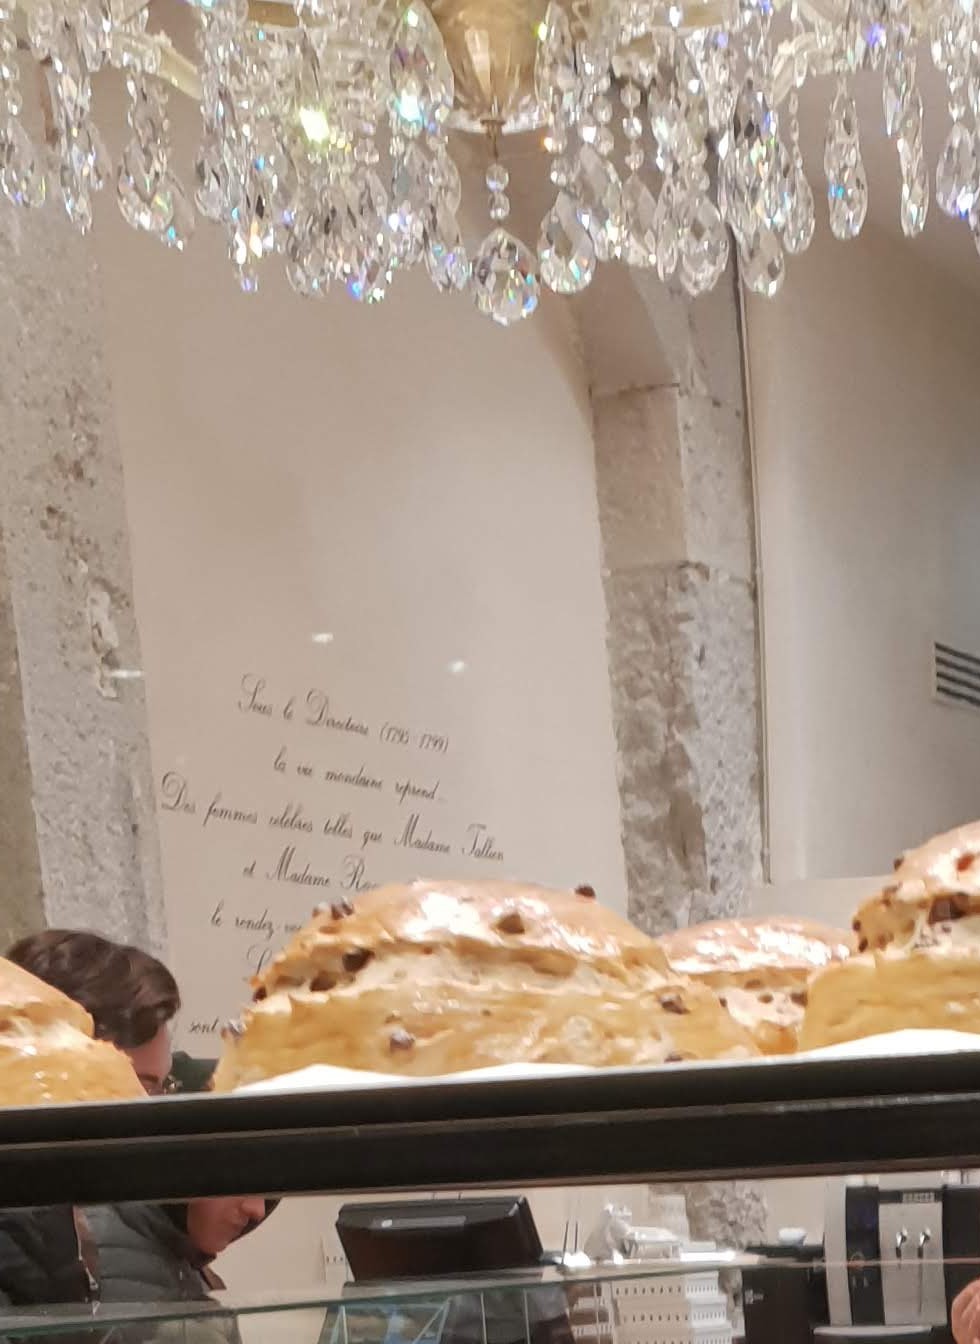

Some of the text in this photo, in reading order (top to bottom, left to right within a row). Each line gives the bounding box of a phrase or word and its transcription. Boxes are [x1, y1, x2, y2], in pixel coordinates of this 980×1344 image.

[238, 673, 273, 717] Sous
[283, 697, 296, 720] le
[274, 746, 286, 774] la
[297, 764, 312, 778] vie
[325, 764, 383, 791] mondaine
[162, 771, 195, 813] Des
[202, 792, 257, 827] femmes
[323, 811, 352, 839] telles
[362, 829, 383, 849] que
[394, 814, 450, 853] Madame
[242, 860, 256, 878] et
[266, 845, 330, 887] Madame
[211, 899, 224, 927] le
